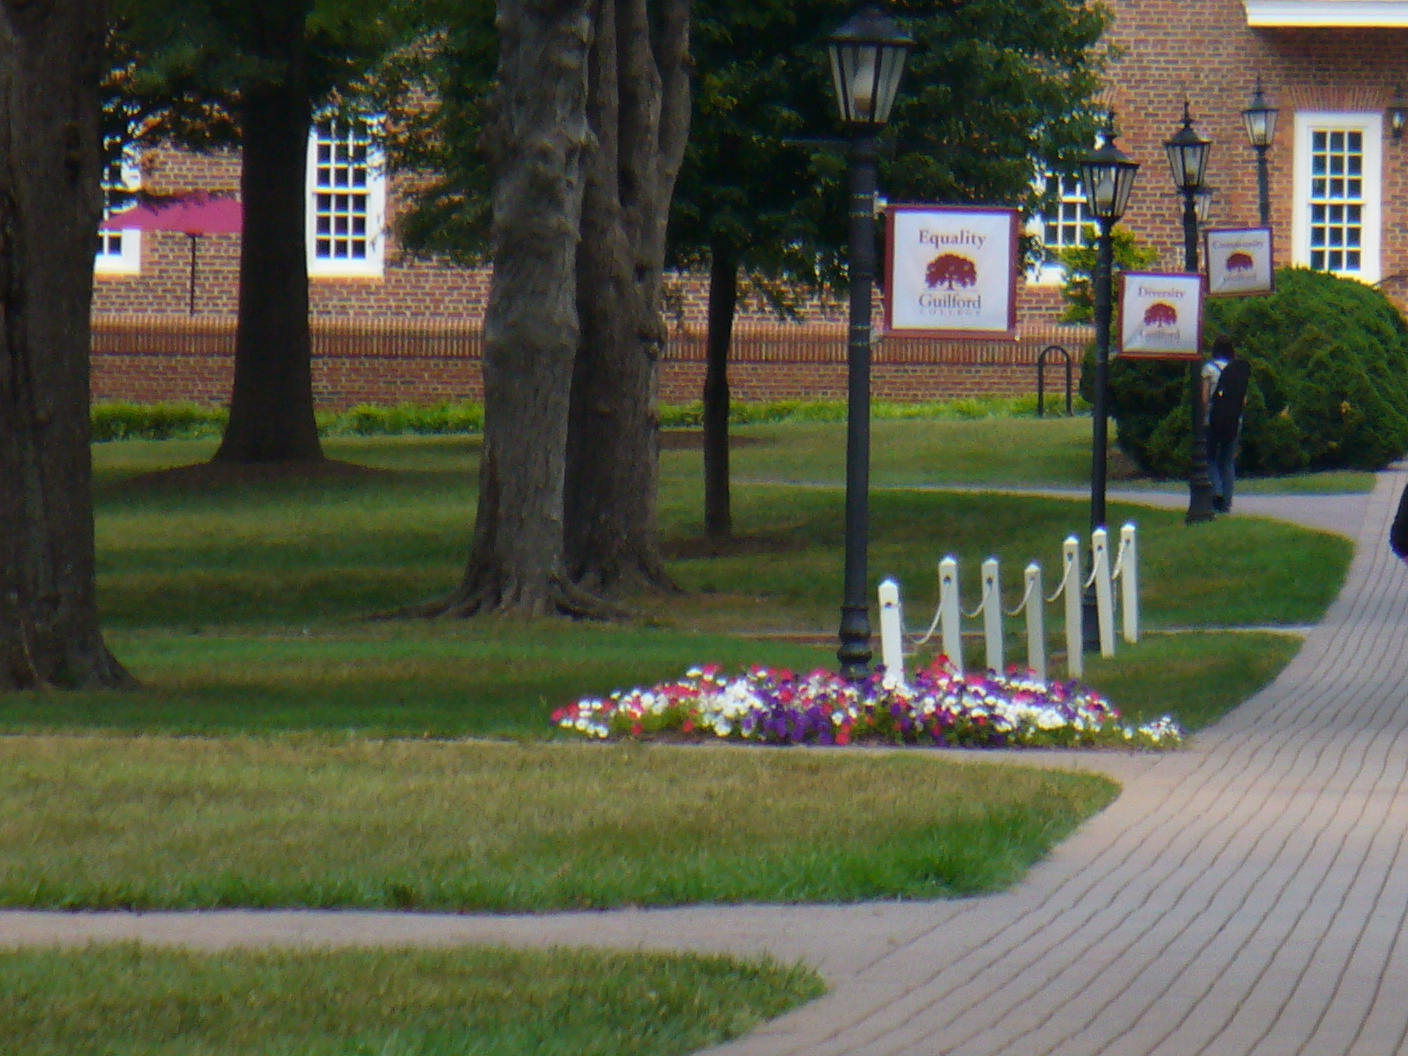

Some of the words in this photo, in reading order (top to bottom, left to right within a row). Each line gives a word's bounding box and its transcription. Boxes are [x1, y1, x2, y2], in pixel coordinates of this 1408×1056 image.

[918, 229, 986, 249] Equality
[1138, 285, 1185, 300] Diversity
[918, 294, 981, 310] Guilford
